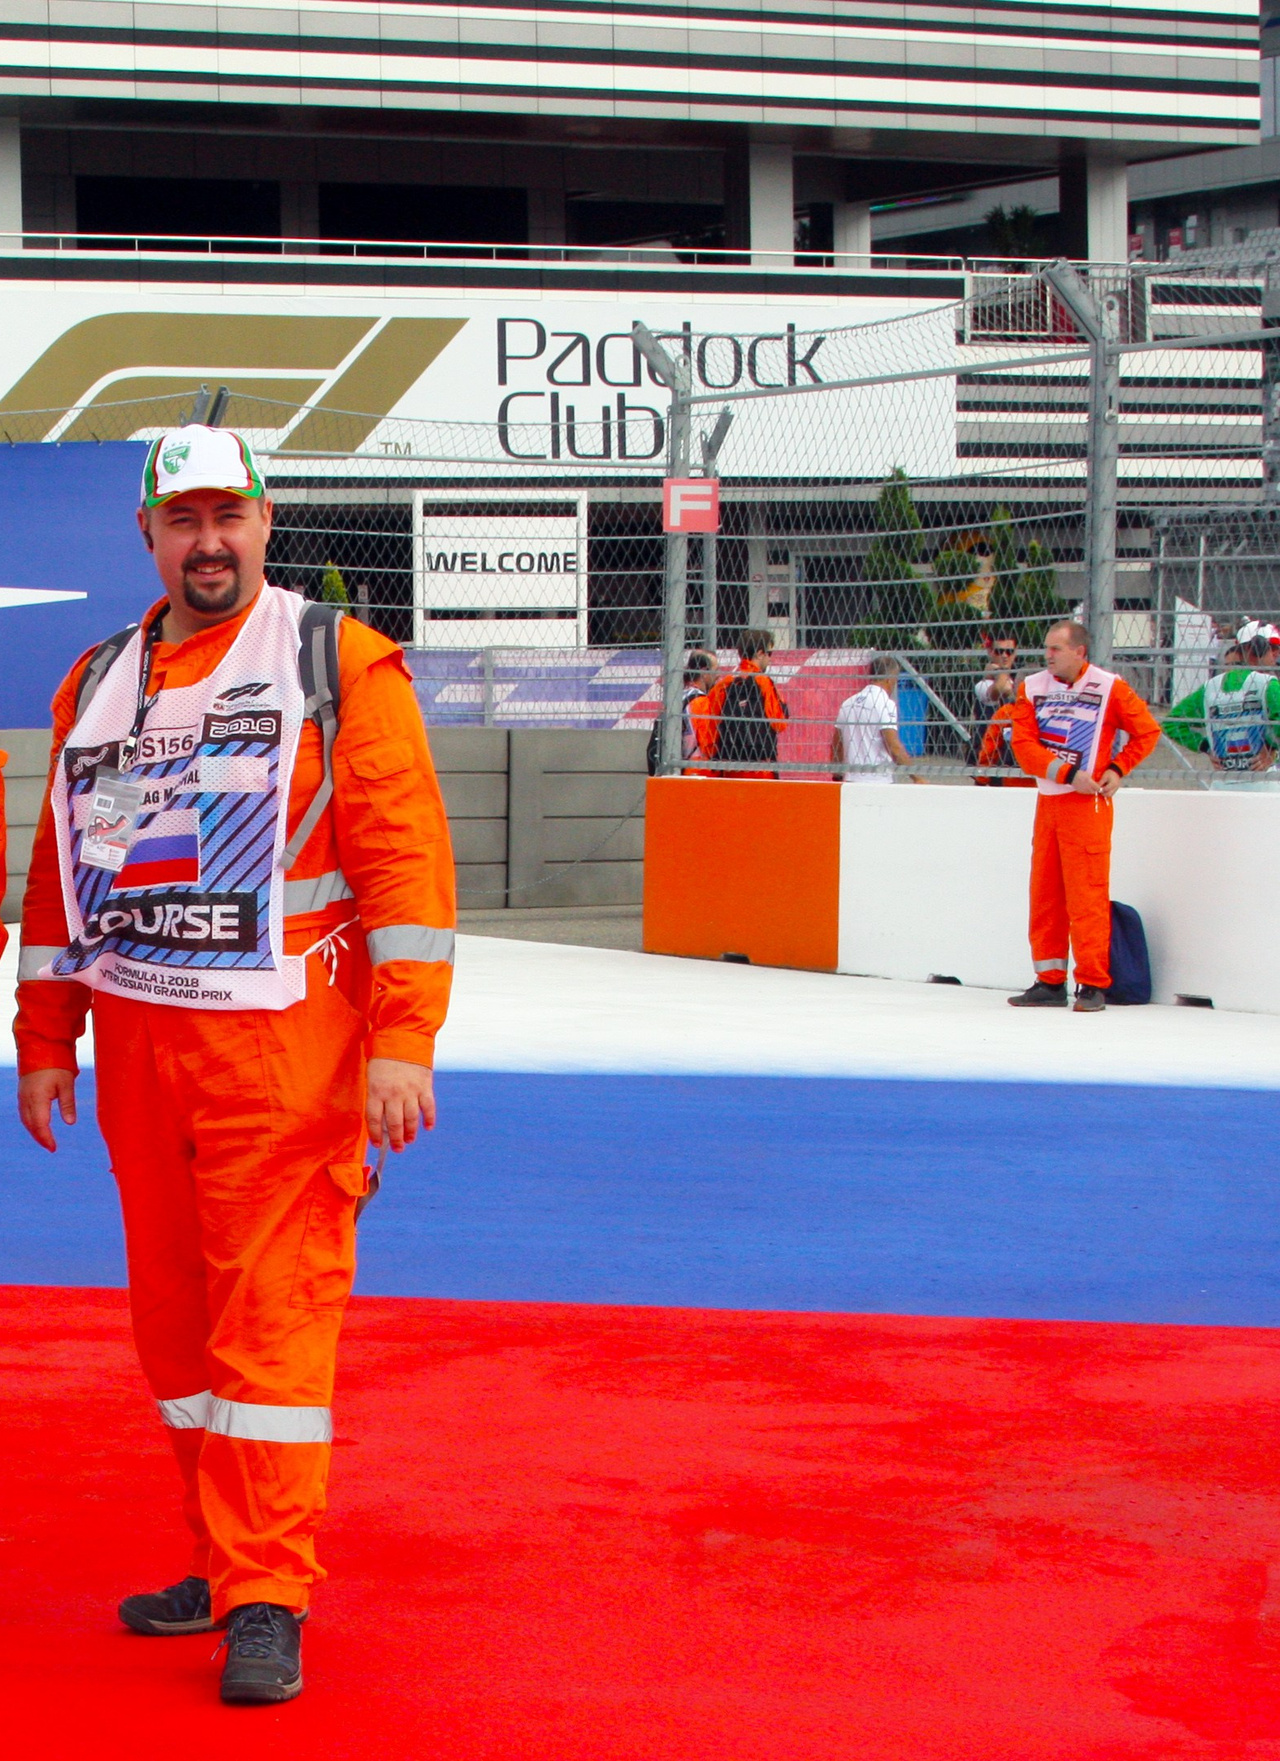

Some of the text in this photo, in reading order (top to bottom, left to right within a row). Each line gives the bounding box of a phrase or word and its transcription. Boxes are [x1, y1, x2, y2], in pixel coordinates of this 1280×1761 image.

[497, 318, 827, 388] Paddock
[498, 391, 665, 459] Club
[670, 485, 713, 527] F
[426, 551, 577, 573] WELCOME
[209, 718, 277, 738] 2018
[131, 734, 194, 763] US156
[141, 790, 160, 806] AG
[78, 904, 240, 947] COURSE
[153, 985, 199, 1000] GRAND
[201, 990, 233, 1001] PRIX
[168, 976, 200, 988] 2018
